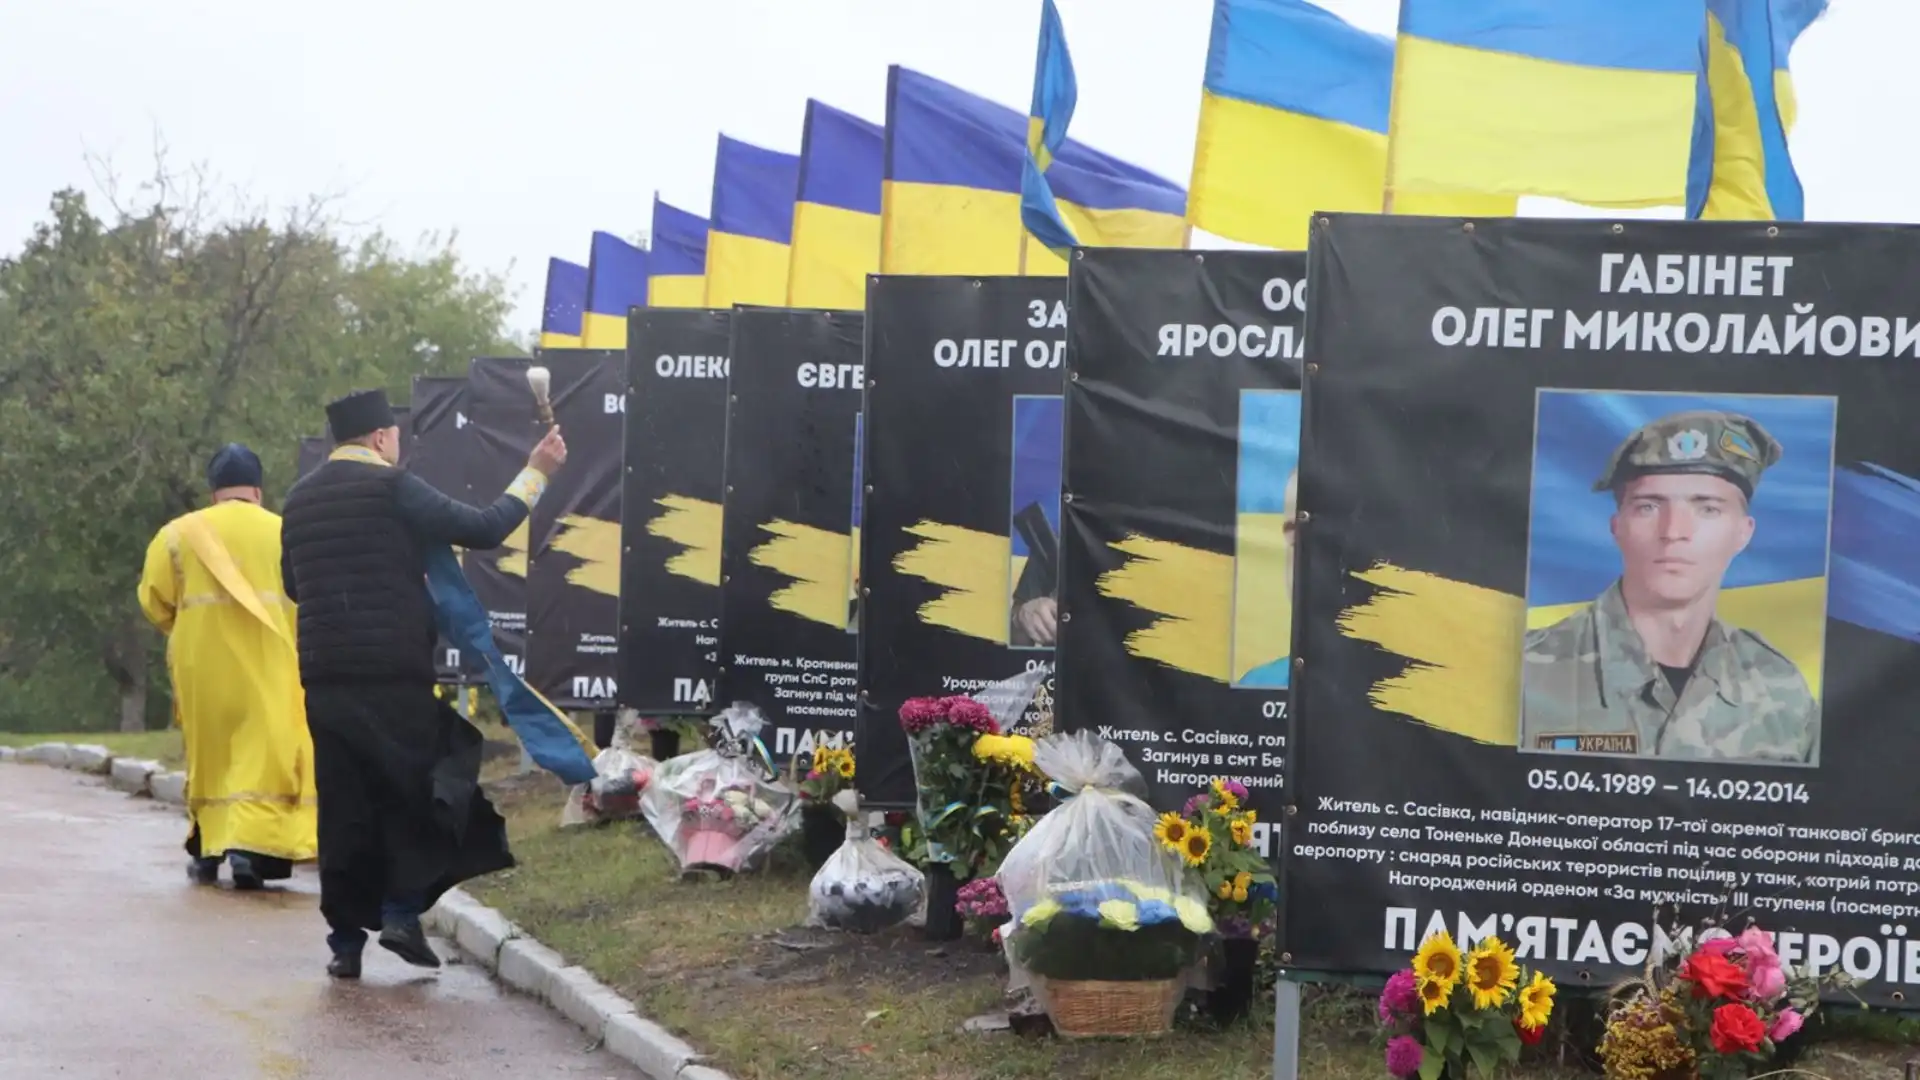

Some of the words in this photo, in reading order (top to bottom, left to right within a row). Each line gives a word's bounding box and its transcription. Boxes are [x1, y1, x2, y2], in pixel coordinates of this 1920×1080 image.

[1600, 252, 1793, 297] ГАБІНЕТ
[1431, 306, 1554, 349] ОЛЕГ
[1564, 302, 1920, 358] МИКОЛАЙОВИ
[934, 338, 1018, 367] ОЛЕГ
[734, 654, 779, 666] Житель
[796, 657, 858, 671] Кропивни
[674, 678, 715, 701] ПА
[765, 673, 799, 685] групи
[802, 673, 828, 685] СпС
[774, 687, 824, 702] Загинув
[825, 690, 843, 702] під
[786, 705, 857, 718] населеного
[1262, 701, 1288, 719] 07.
[1098, 725, 1159, 742] Житель
[1164, 732, 1177, 743] с.
[1182, 729, 1253, 748] Сасівка,
[1142, 748, 1210, 768] Загинув
[1214, 754, 1223, 765] в
[1228, 755, 1257, 767] смт
[1262, 753, 1286, 768] Бе
[1528, 768, 1656, 796] 05.04.1989
[1686, 777, 1810, 804] 14.09.2014
[1318, 797, 1380, 814] Житель
[1385, 804, 1398, 815] с.
[1404, 802, 1476, 822] Сасівка,
[1481, 808, 1653, 832] навідник-оператор
[1657, 816, 1708, 834] 17-тої
[1711, 822, 1784, 838] окремої
[1787, 825, 1868, 842] танкової
[1308, 821, 1375, 840] поблизу
[1380, 827, 1420, 840] села
[1425, 826, 1503, 845] Тоненьке
[1507, 831, 1598, 851] Донецької
[1602, 838, 1668, 855] області
[1673, 841, 1699, 858] під
[1704, 846, 1737, 859] час
[1741, 846, 1819, 864] оборони
[1825, 850, 1899, 869] підходів
[1293, 844, 1385, 864] аеропорту
[1399, 850, 1462, 868] снаряд
[1466, 854, 1562, 873] російських
[1566, 860, 1662, 878] терористів
[1667, 867, 1737, 884] поцілив
[1741, 871, 1751, 886] у
[1755, 873, 1801, 888] танк,
[1805, 875, 1870, 893] котрий
[1875, 879, 1920, 896] потр
[1388, 870, 1517, 893] Нагороджений
[1521, 881, 1598, 898] орденом
[1603, 885, 1636, 900] «За
[1640, 888, 1728, 906] мужність»
[1753, 896, 1826, 912] ступеня
[1384, 906, 1734, 970] ПАМ’ЯТАЄМ
